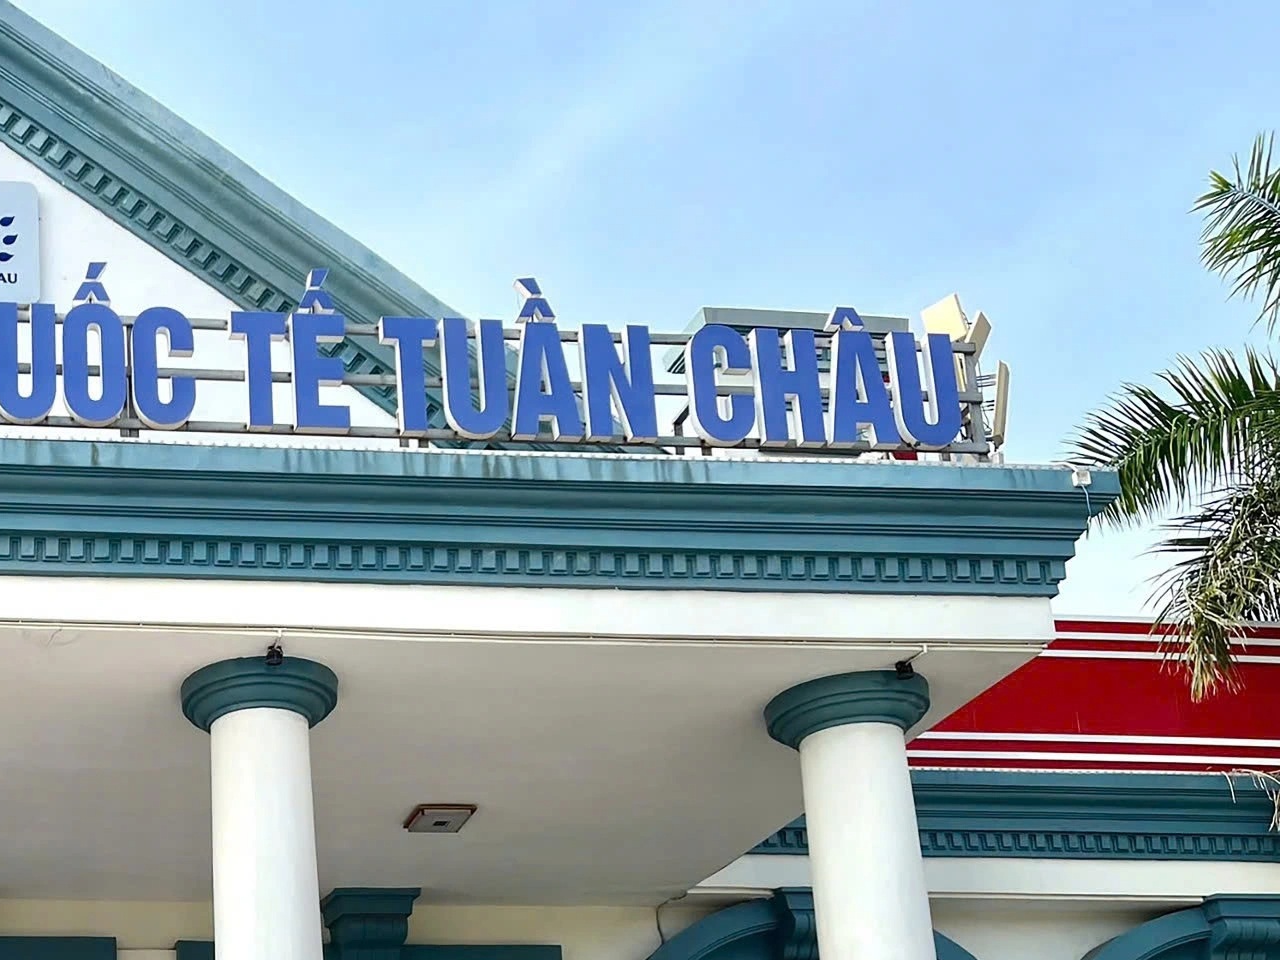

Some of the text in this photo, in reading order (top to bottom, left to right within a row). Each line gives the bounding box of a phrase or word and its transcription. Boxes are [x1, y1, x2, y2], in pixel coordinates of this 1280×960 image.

[228, 269, 351, 435] TẾ
[379, 278, 658, 444] TUẦN
[685, 307, 964, 451] CHÂU
